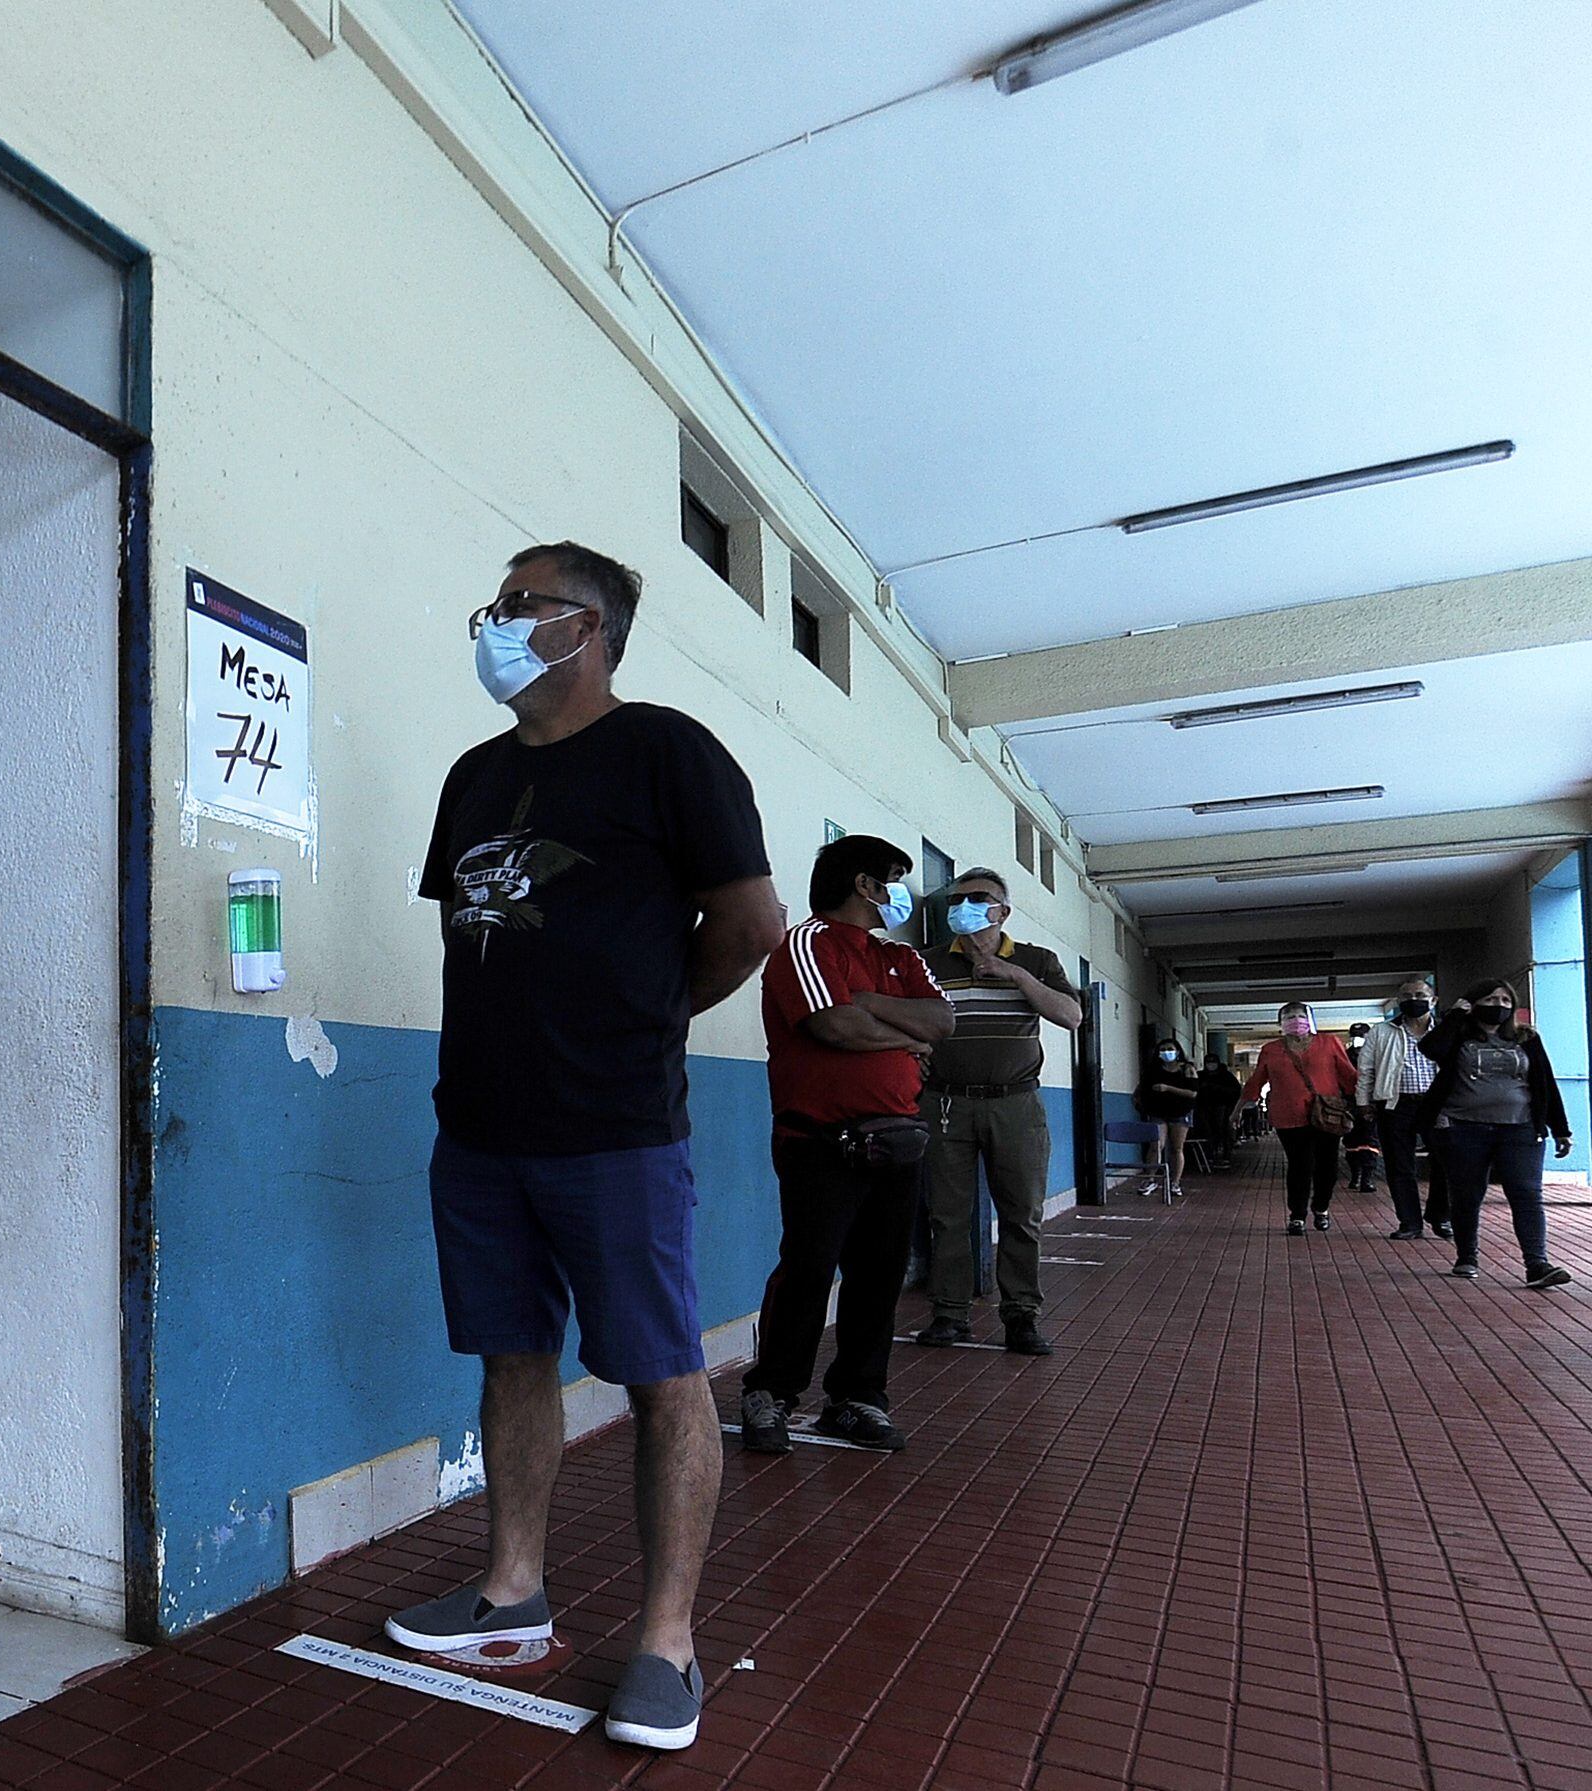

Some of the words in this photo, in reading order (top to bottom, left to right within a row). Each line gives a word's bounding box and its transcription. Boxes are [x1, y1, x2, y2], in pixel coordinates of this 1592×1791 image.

[215, 712, 282, 795] 74
[353, 1657, 438, 1685] DISTANCIA
[440, 1681, 467, 1693] SU
[470, 1688, 576, 1722] MANTENGA
